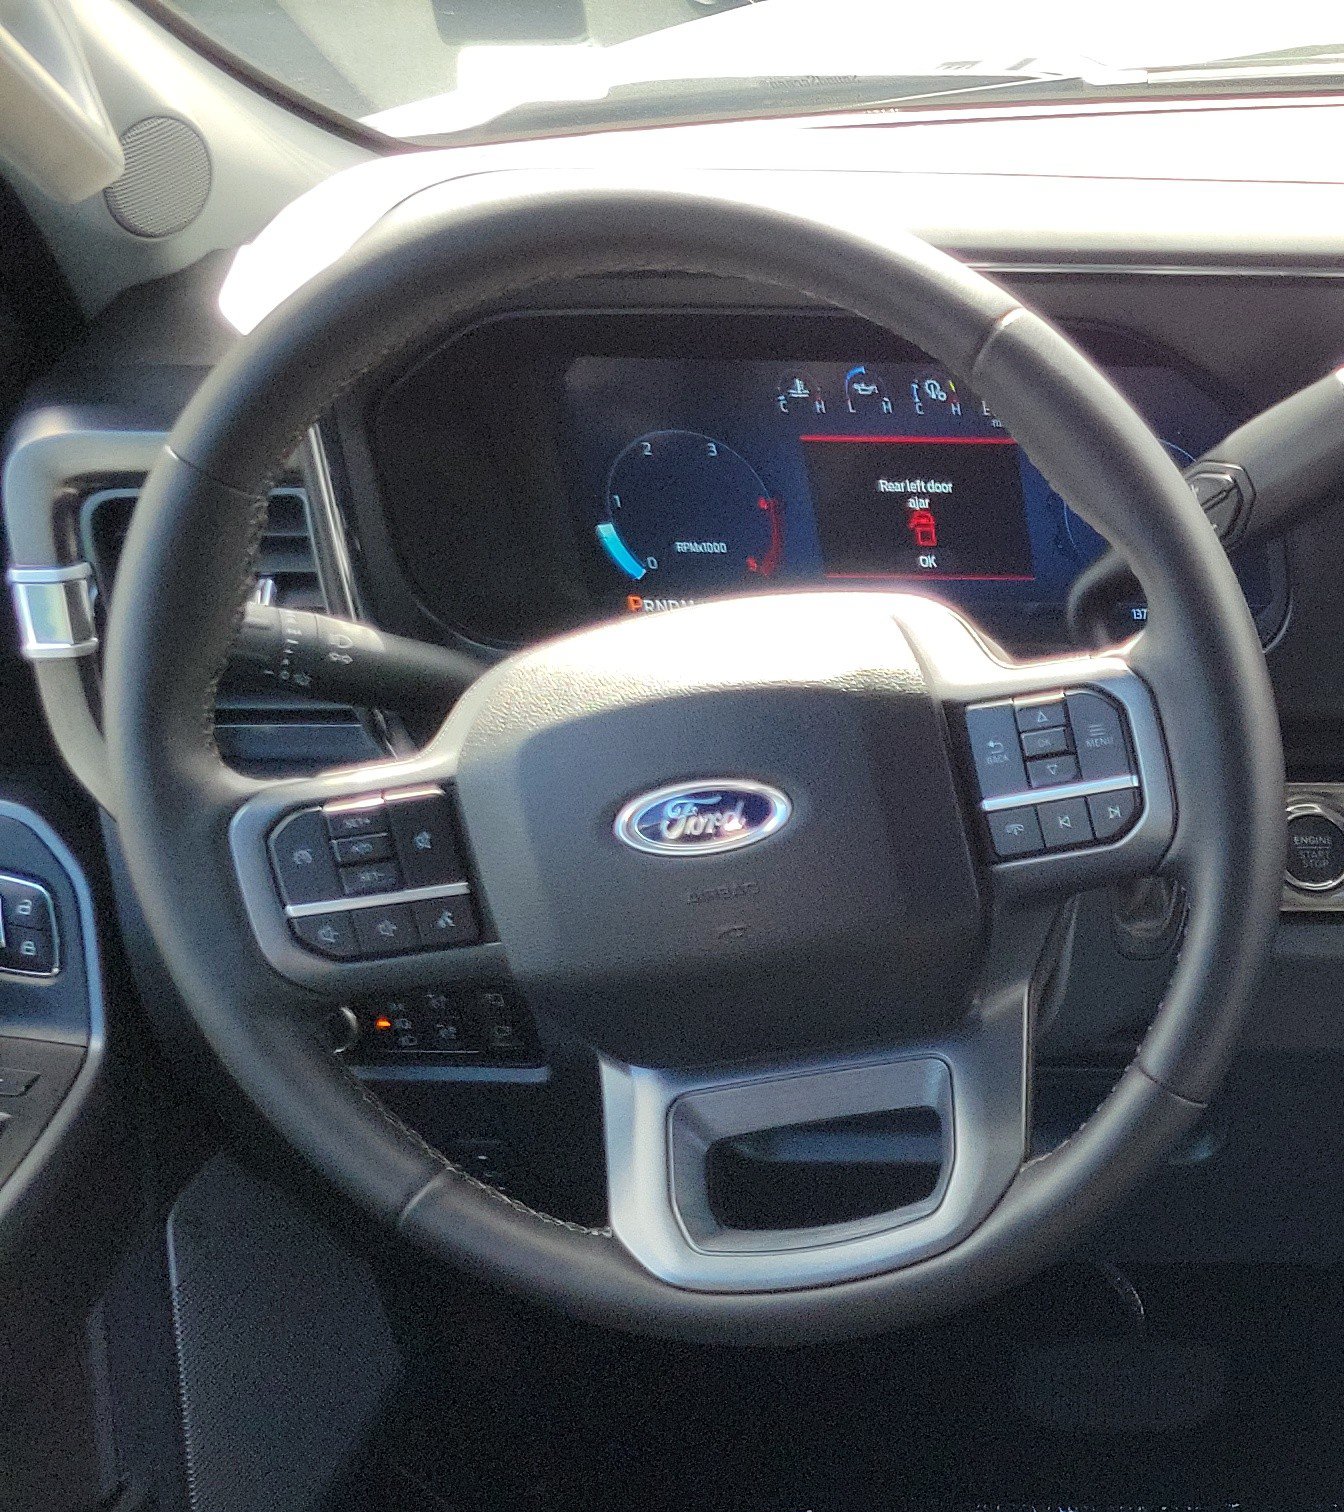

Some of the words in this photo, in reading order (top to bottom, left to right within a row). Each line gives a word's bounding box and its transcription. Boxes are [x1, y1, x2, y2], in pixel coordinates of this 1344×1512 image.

[642, 442, 653, 456] 2
[707, 442, 719, 457] 3
[877, 479, 905, 493] Rear
[905, 479, 927, 493] left
[926, 479, 954, 494] door
[612, 494, 622, 508] 1
[908, 496, 930, 511] ajar
[646, 556, 659, 570] 0
[918, 554, 938, 568] OK
[1085, 737, 1115, 748] MENU
[660, 795, 747, 840] Ford
[1293, 835, 1333, 846] ENGINE
